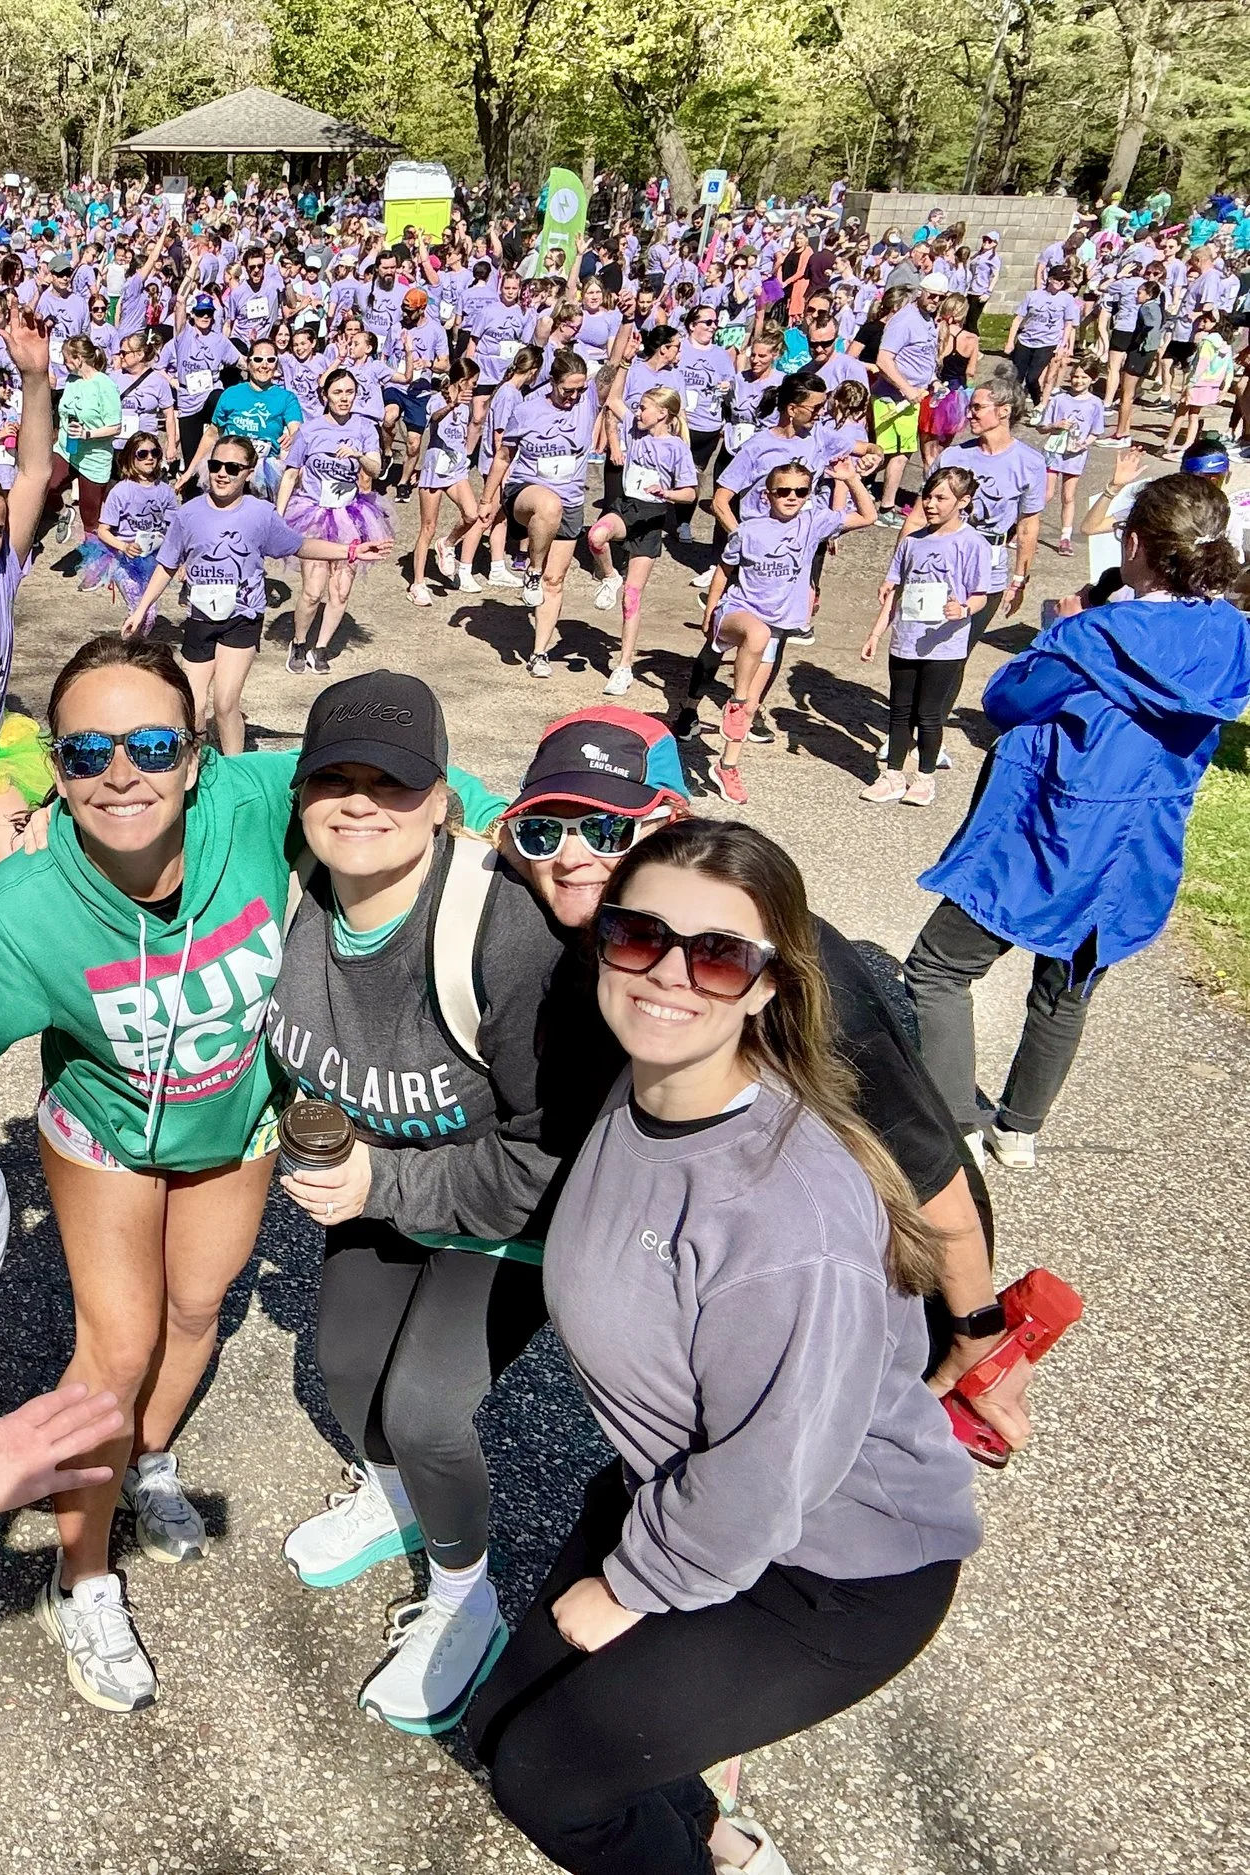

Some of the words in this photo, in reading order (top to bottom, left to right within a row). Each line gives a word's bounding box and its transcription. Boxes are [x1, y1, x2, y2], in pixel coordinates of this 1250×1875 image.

[197, 380, 202, 388] 1
[123, 424, 127, 432] 1
[737, 433, 742, 441] 1
[526, 442, 557, 453] Girls
[313, 459, 339, 469] Girls
[553, 465, 559, 475] 1
[636, 479, 642, 490] 1
[190, 565, 225, 578] Girls
[752, 561, 784, 573] Girls
[767, 567, 790, 579] run
[209, 599, 217, 612] 1
[917, 597, 924, 611] 1
[589, 760, 605, 770] EAU
[604, 763, 630, 778] CLAIRE
[91, 919, 283, 1042] RUN
[111, 1020, 237, 1080] EC
[267, 996, 313, 1070] EAU
[318, 1046, 459, 1115] CLAIRE
[164, 1072, 223, 1096] CLAIRE
